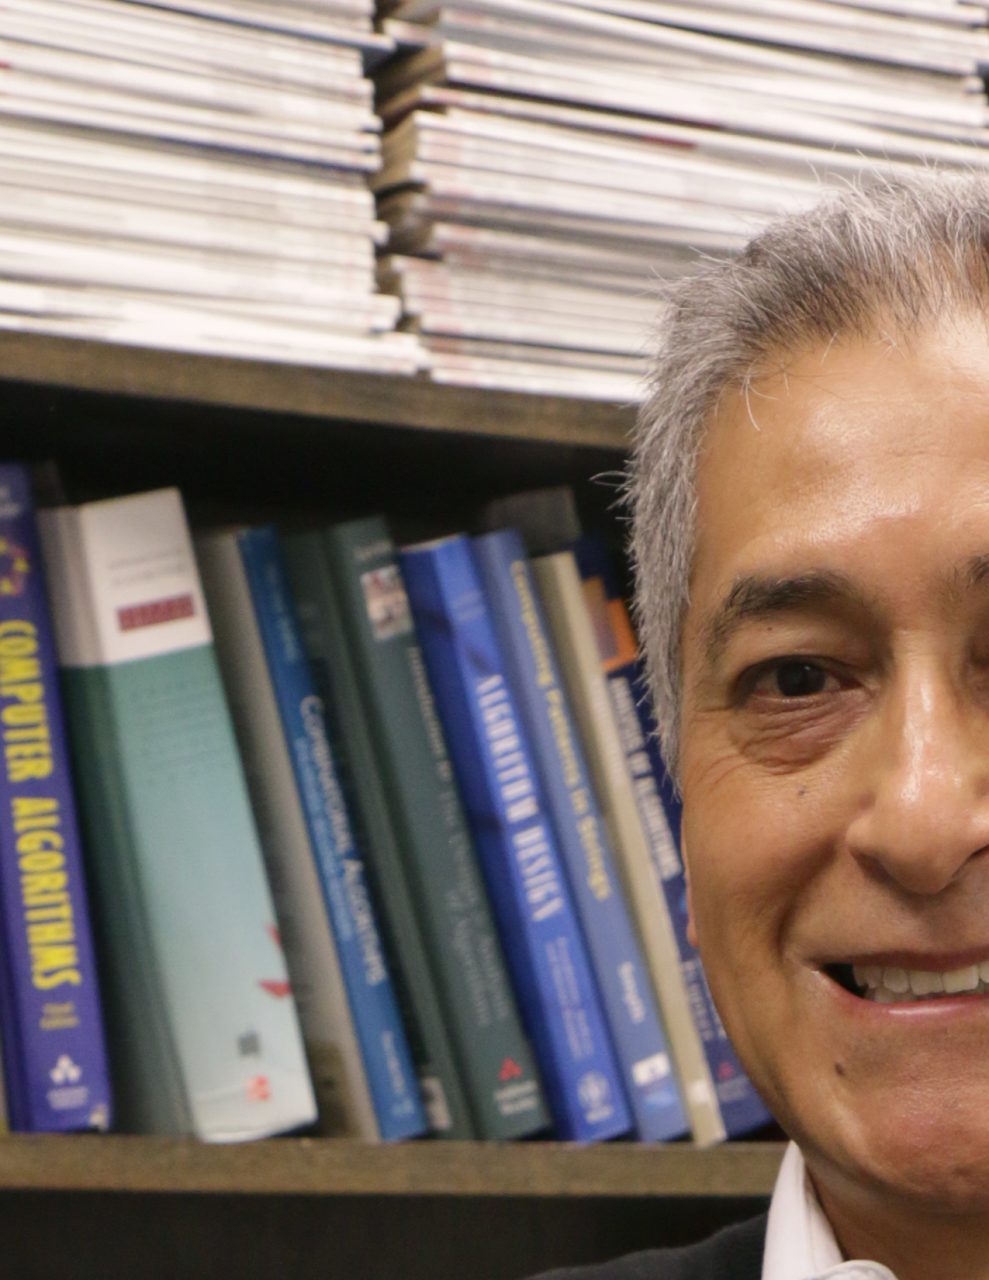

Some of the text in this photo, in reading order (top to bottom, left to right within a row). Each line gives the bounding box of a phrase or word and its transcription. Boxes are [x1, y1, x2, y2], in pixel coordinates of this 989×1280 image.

[509, 560, 553, 688] Computing
[0, 619, 54, 783] COMPUTER
[546, 688, 581, 789] Patterns
[476, 673, 563, 922] ALGORITHM DESIGN
[571, 788, 591, 816] in
[576, 815, 613, 901] Strings
[11, 796, 82, 991] ALGORITHMS
